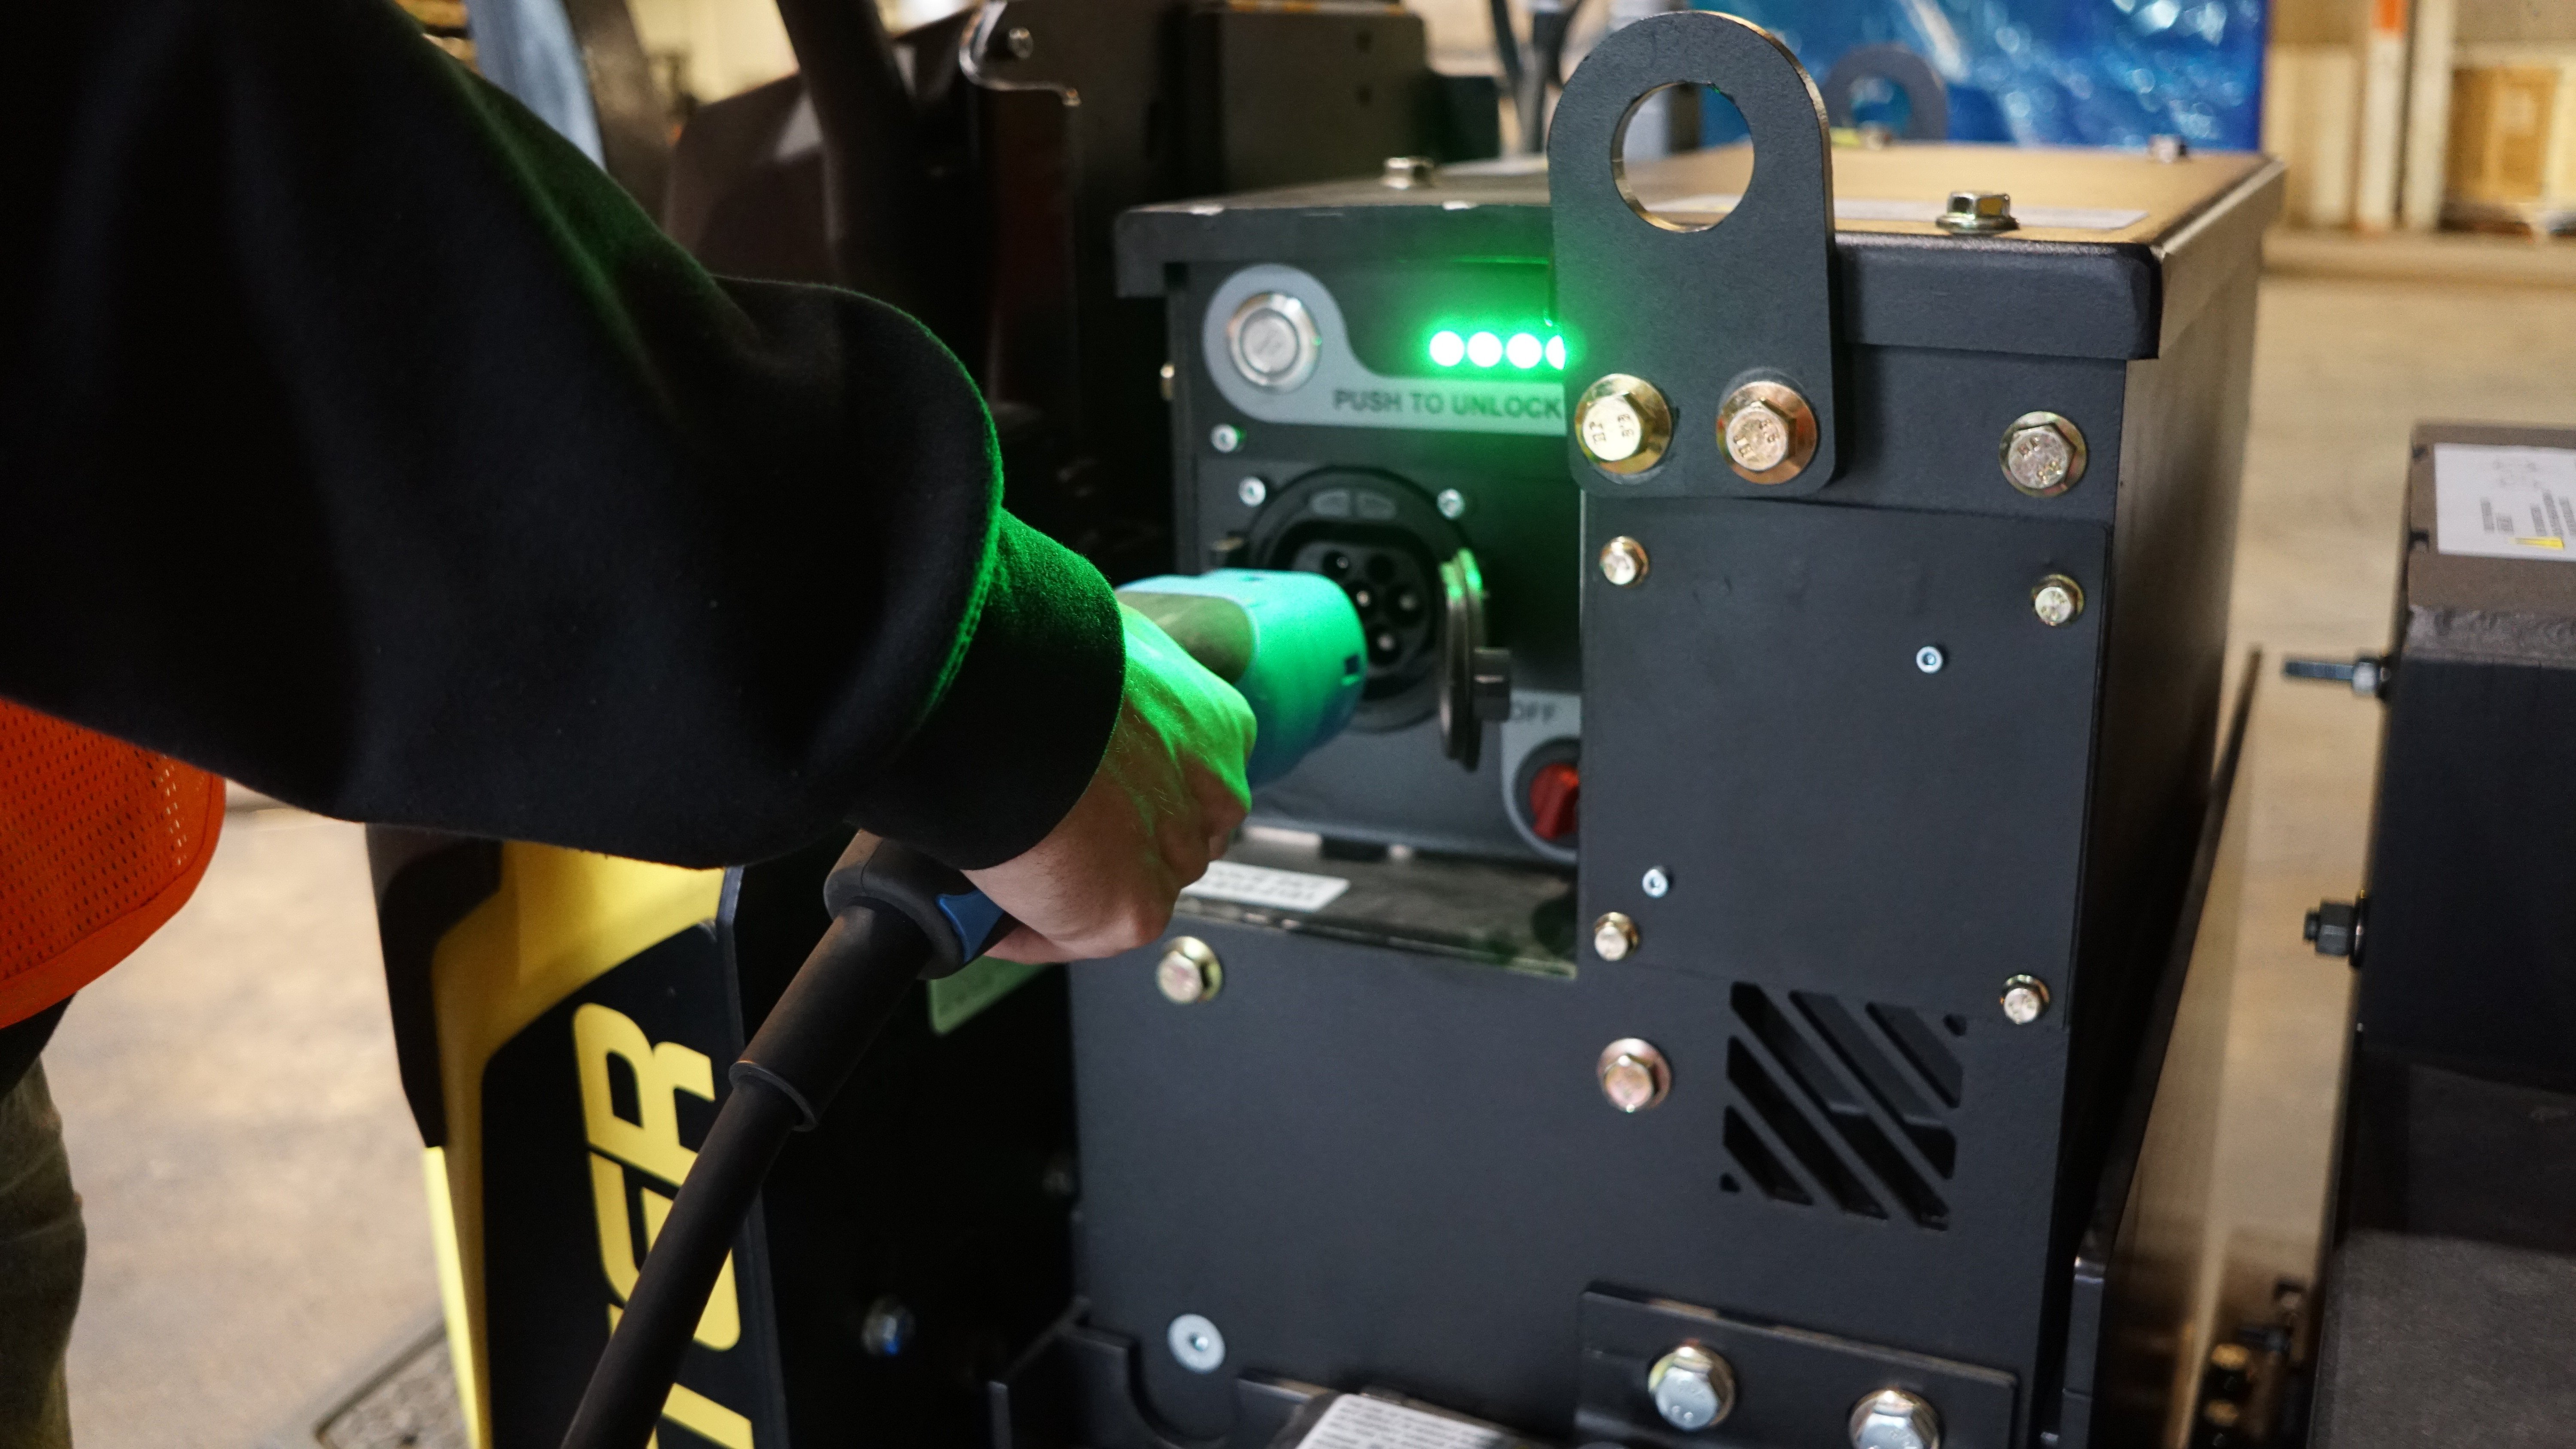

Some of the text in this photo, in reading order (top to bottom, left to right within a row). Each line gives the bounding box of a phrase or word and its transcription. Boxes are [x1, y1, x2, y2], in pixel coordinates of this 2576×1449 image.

[1333, 389, 1562, 419] PUSH TO UNLOCK
[1509, 700, 1556, 722] OFF
